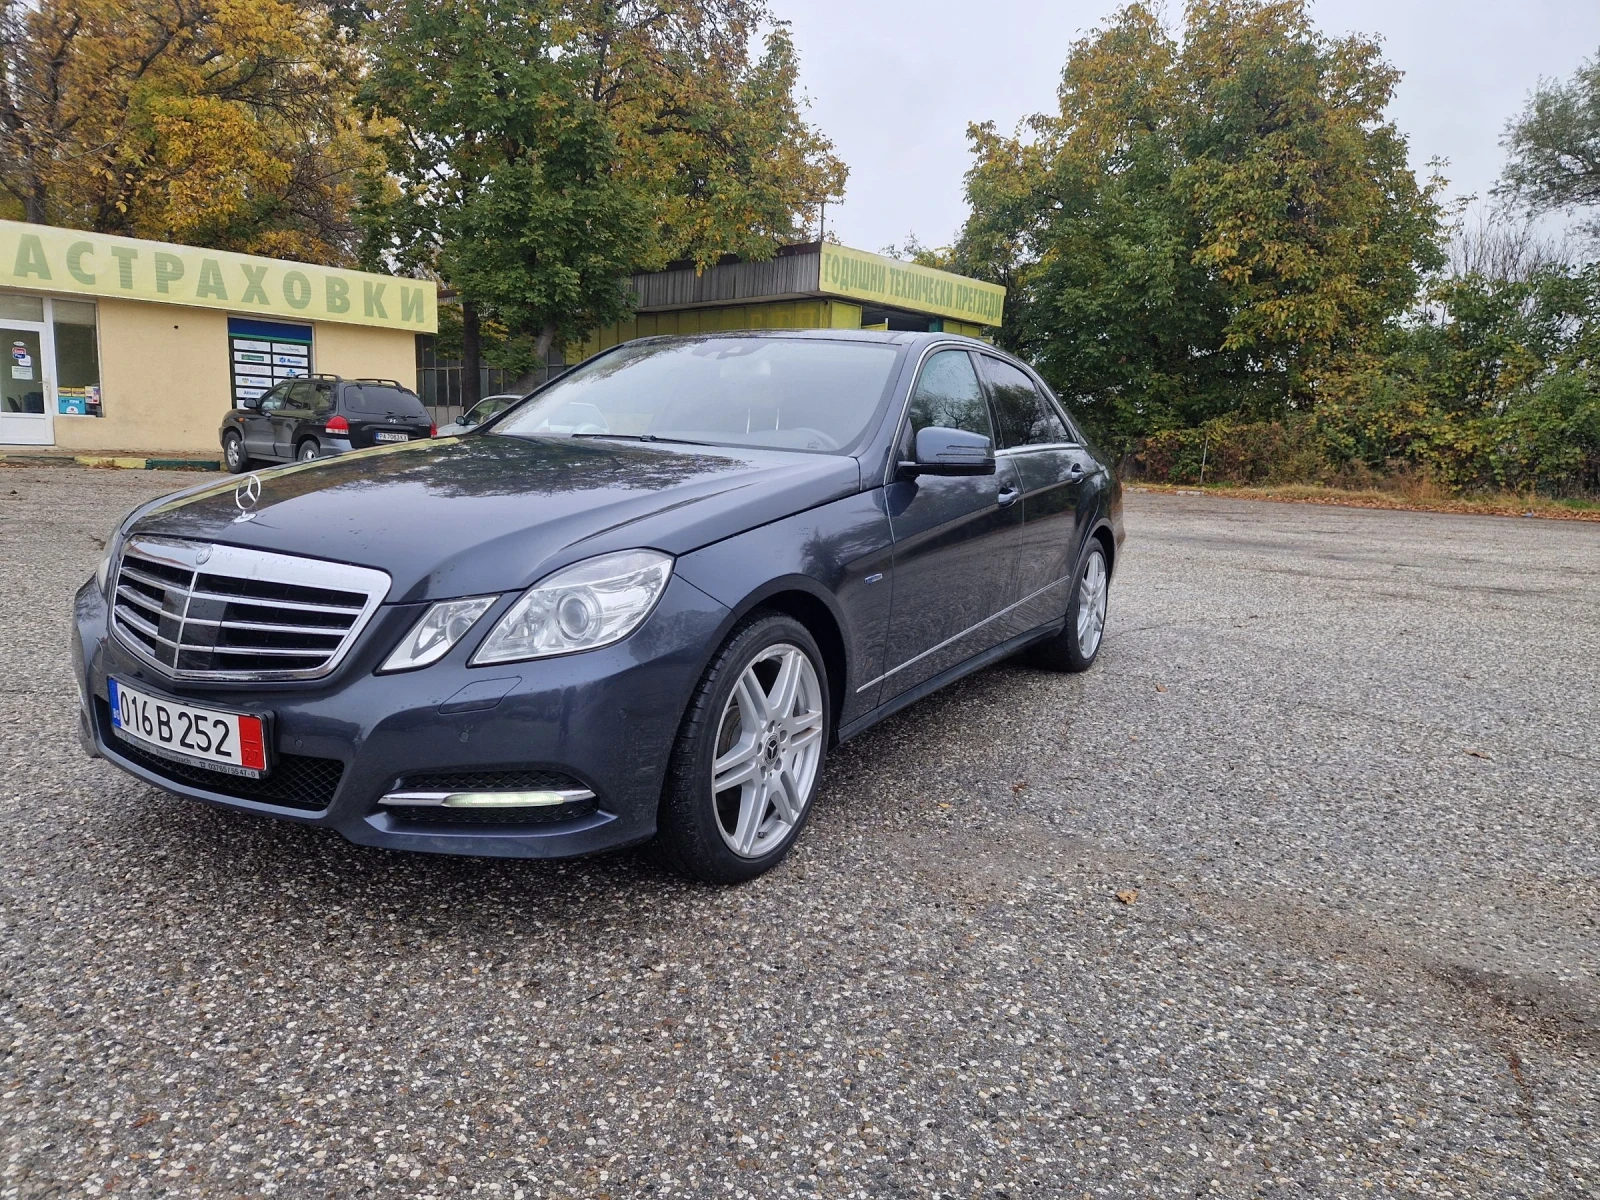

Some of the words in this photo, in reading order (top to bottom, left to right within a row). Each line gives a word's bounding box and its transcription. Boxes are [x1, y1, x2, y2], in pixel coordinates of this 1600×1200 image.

[13, 233, 425, 324] АСТРАХОВКИ
[824, 252, 886, 294] ГОДИШНИ
[889, 267, 953, 309] ТЕХНИЧЕСКИ
[956, 284, 1002, 321] ПРЕГЛЕДИ
